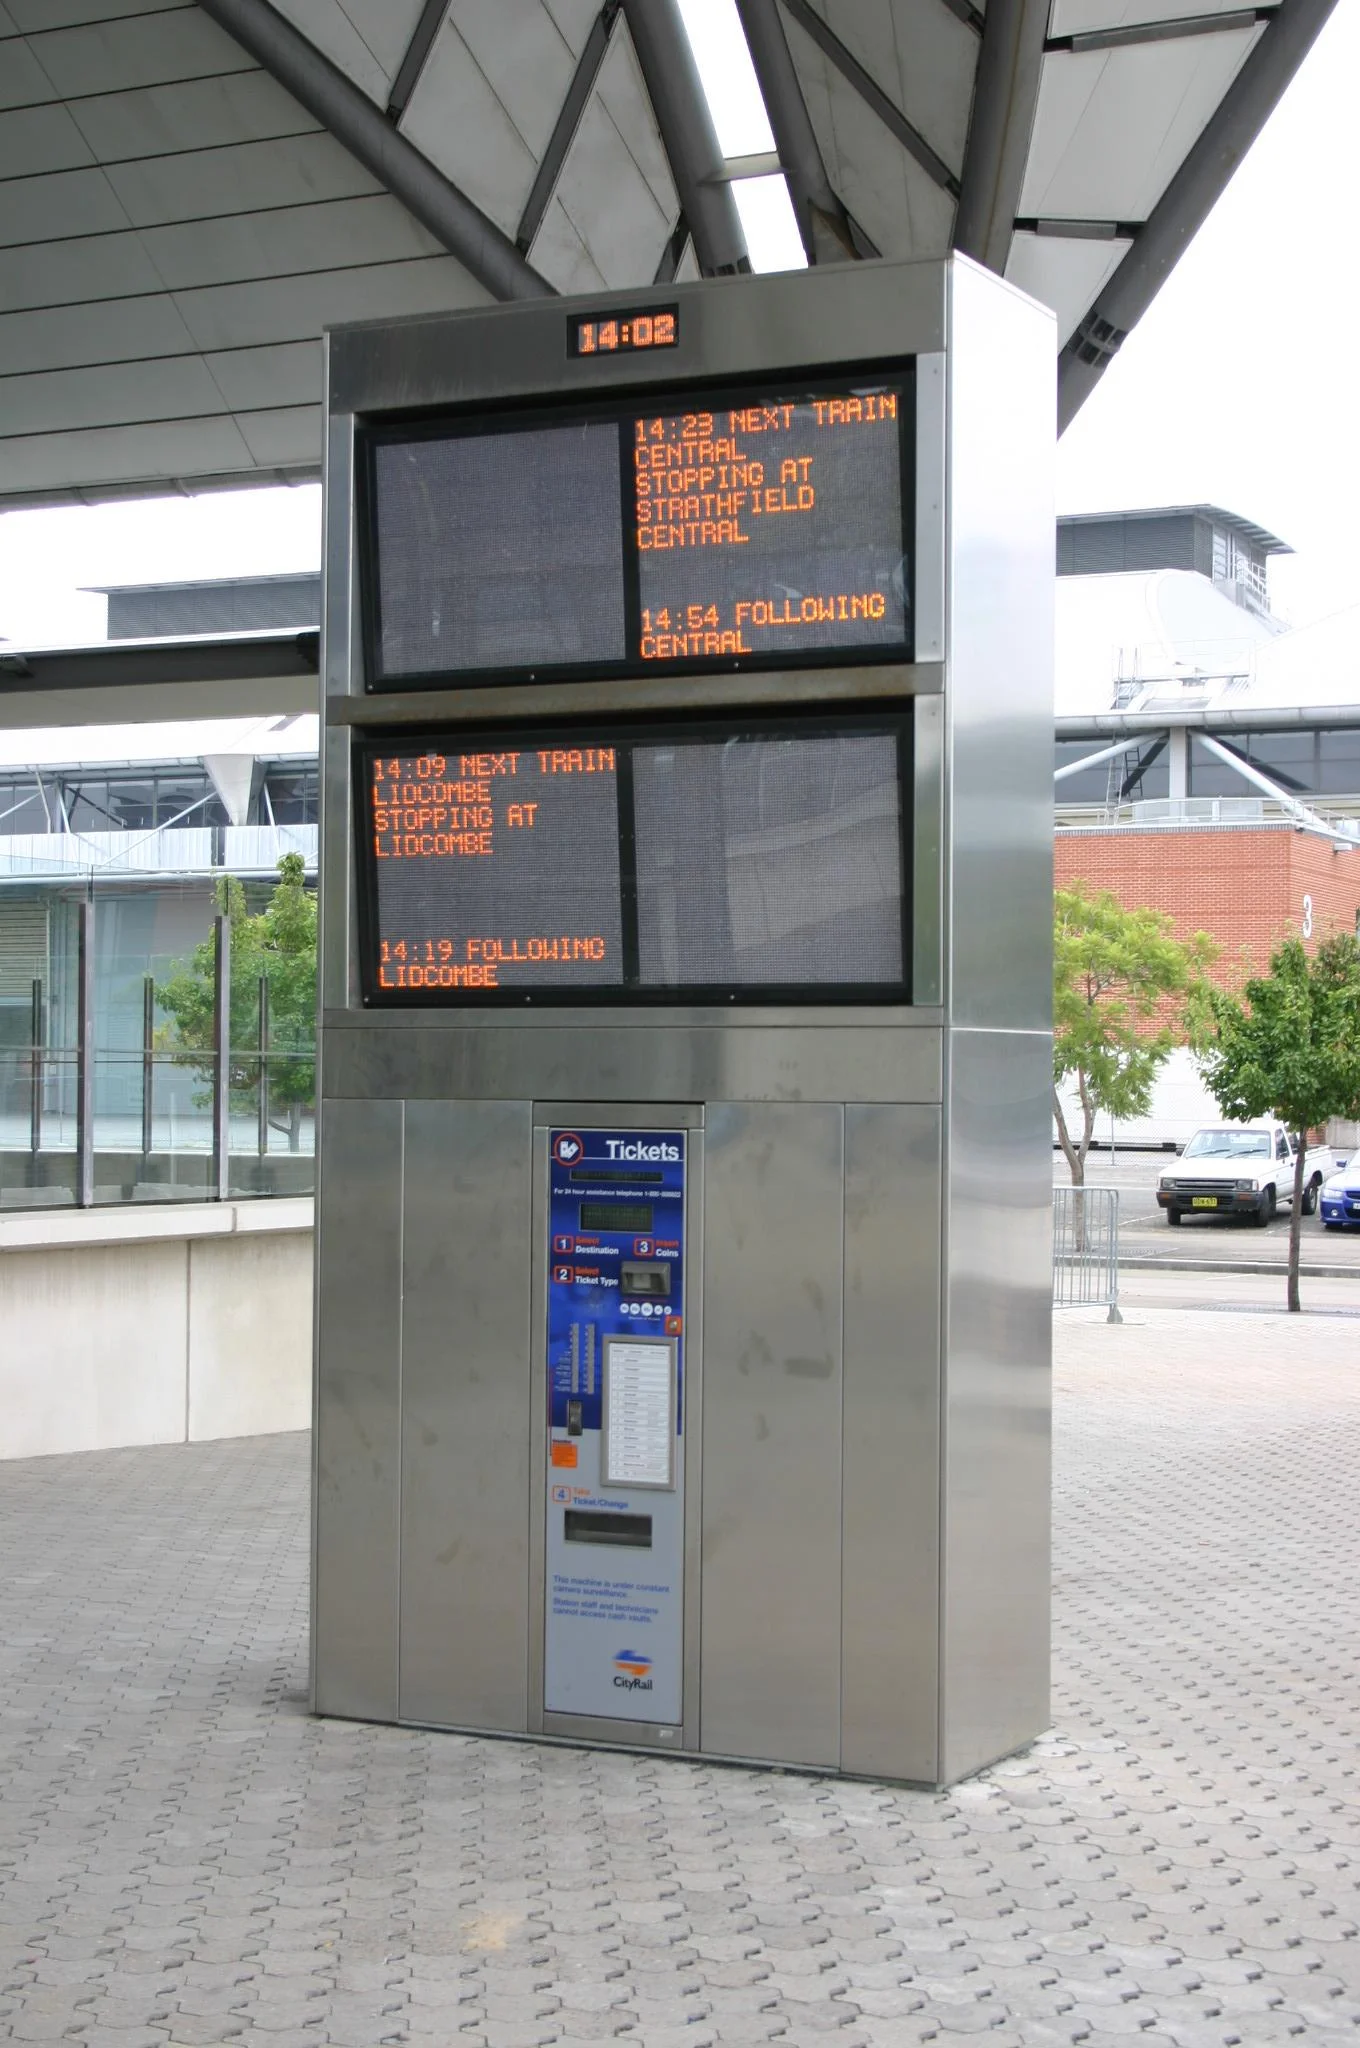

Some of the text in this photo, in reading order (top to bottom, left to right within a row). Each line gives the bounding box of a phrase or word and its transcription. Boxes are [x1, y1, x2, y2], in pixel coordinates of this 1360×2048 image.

[580, 313, 674, 353] 14:02
[634, 393, 897, 442] 14:23 NEXT TRAIN
[634, 437, 747, 469] CENTRAL
[636, 457, 813, 496] STOPPING AT
[636, 485, 815, 523] STRATHFIELD
[637, 519, 749, 549] CENTRAL
[641, 593, 885, 632] 14:54 FOLLOWING
[640, 630, 752, 659] CENTRAL
[373, 748, 616, 780] 14:09 NEXT TRAIN
[373, 780, 492, 806] LIDCOMBE
[375, 804, 539, 831] STOPPING AT
[375, 832, 493, 857] LIDCOMBE
[1303, 894, 1312, 938] 3
[381, 937, 605, 962] 14:19 FOLLOWING
[380, 964, 499, 988] LIDCOMBE
[606, 1140, 679, 1160] Tickets
[554, 1187, 564, 1195] For
[560, 1238, 567, 1250] 1
[575, 1245, 619, 1254] Destination
[640, 1241, 648, 1252] 3
[655, 1248, 679, 1257] Coins
[560, 1268, 567, 1280] 2
[575, 1276, 619, 1287] Ticket Type
[558, 1487, 566, 1500] 4
[573, 1496, 629, 1510] Ticket/Change
[553, 1574, 569, 1584] This
[570, 1577, 602, 1587] machine
[612, 1581, 634, 1590] under
[636, 1583, 670, 1593] constant
[553, 1597, 659, 1615] Station staff and technicians
[553, 1607, 578, 1616] cannot
[580, 1610, 606, 1619] access
[608, 1612, 626, 1621] cash
[613, 1676, 653, 1692] CityRail
